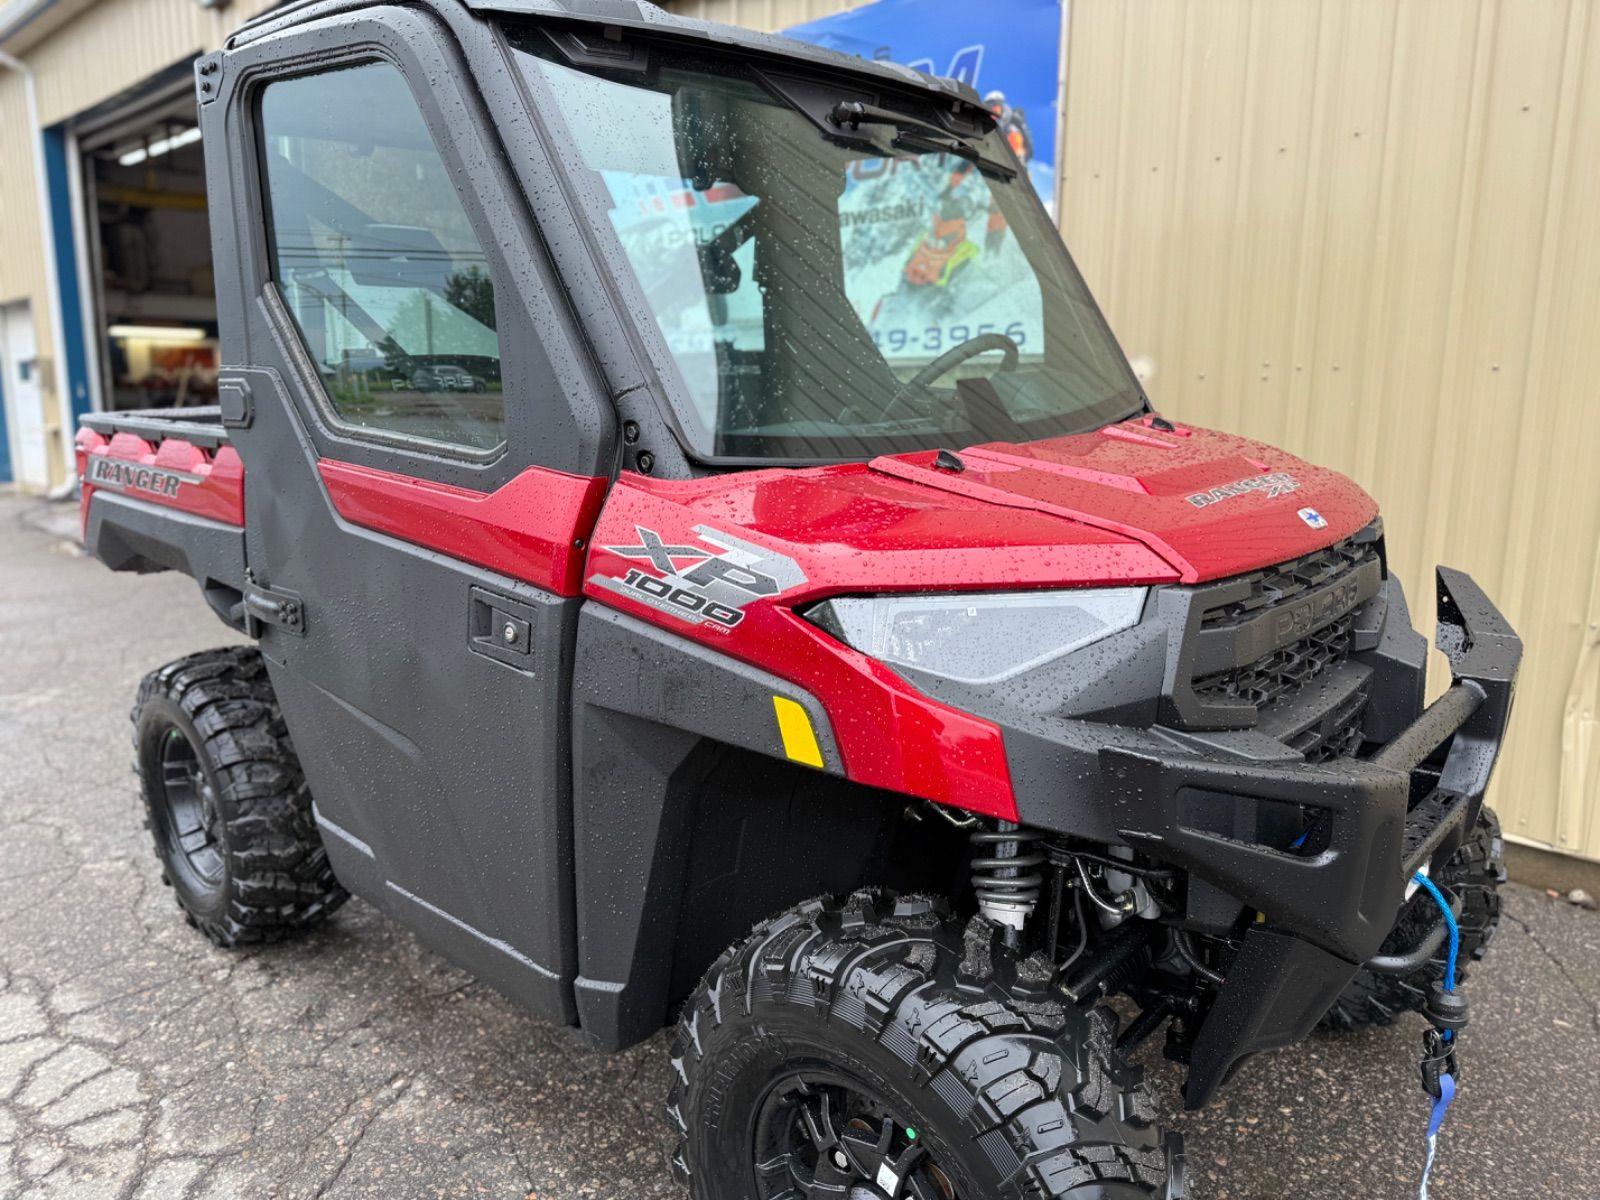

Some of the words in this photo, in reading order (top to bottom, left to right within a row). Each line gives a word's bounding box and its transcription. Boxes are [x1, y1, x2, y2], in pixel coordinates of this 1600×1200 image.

[95, 459, 181, 498] RANGER
[599, 525, 781, 598] XP
[622, 567, 746, 628] 1000
[703, 620, 731, 636] CAM
